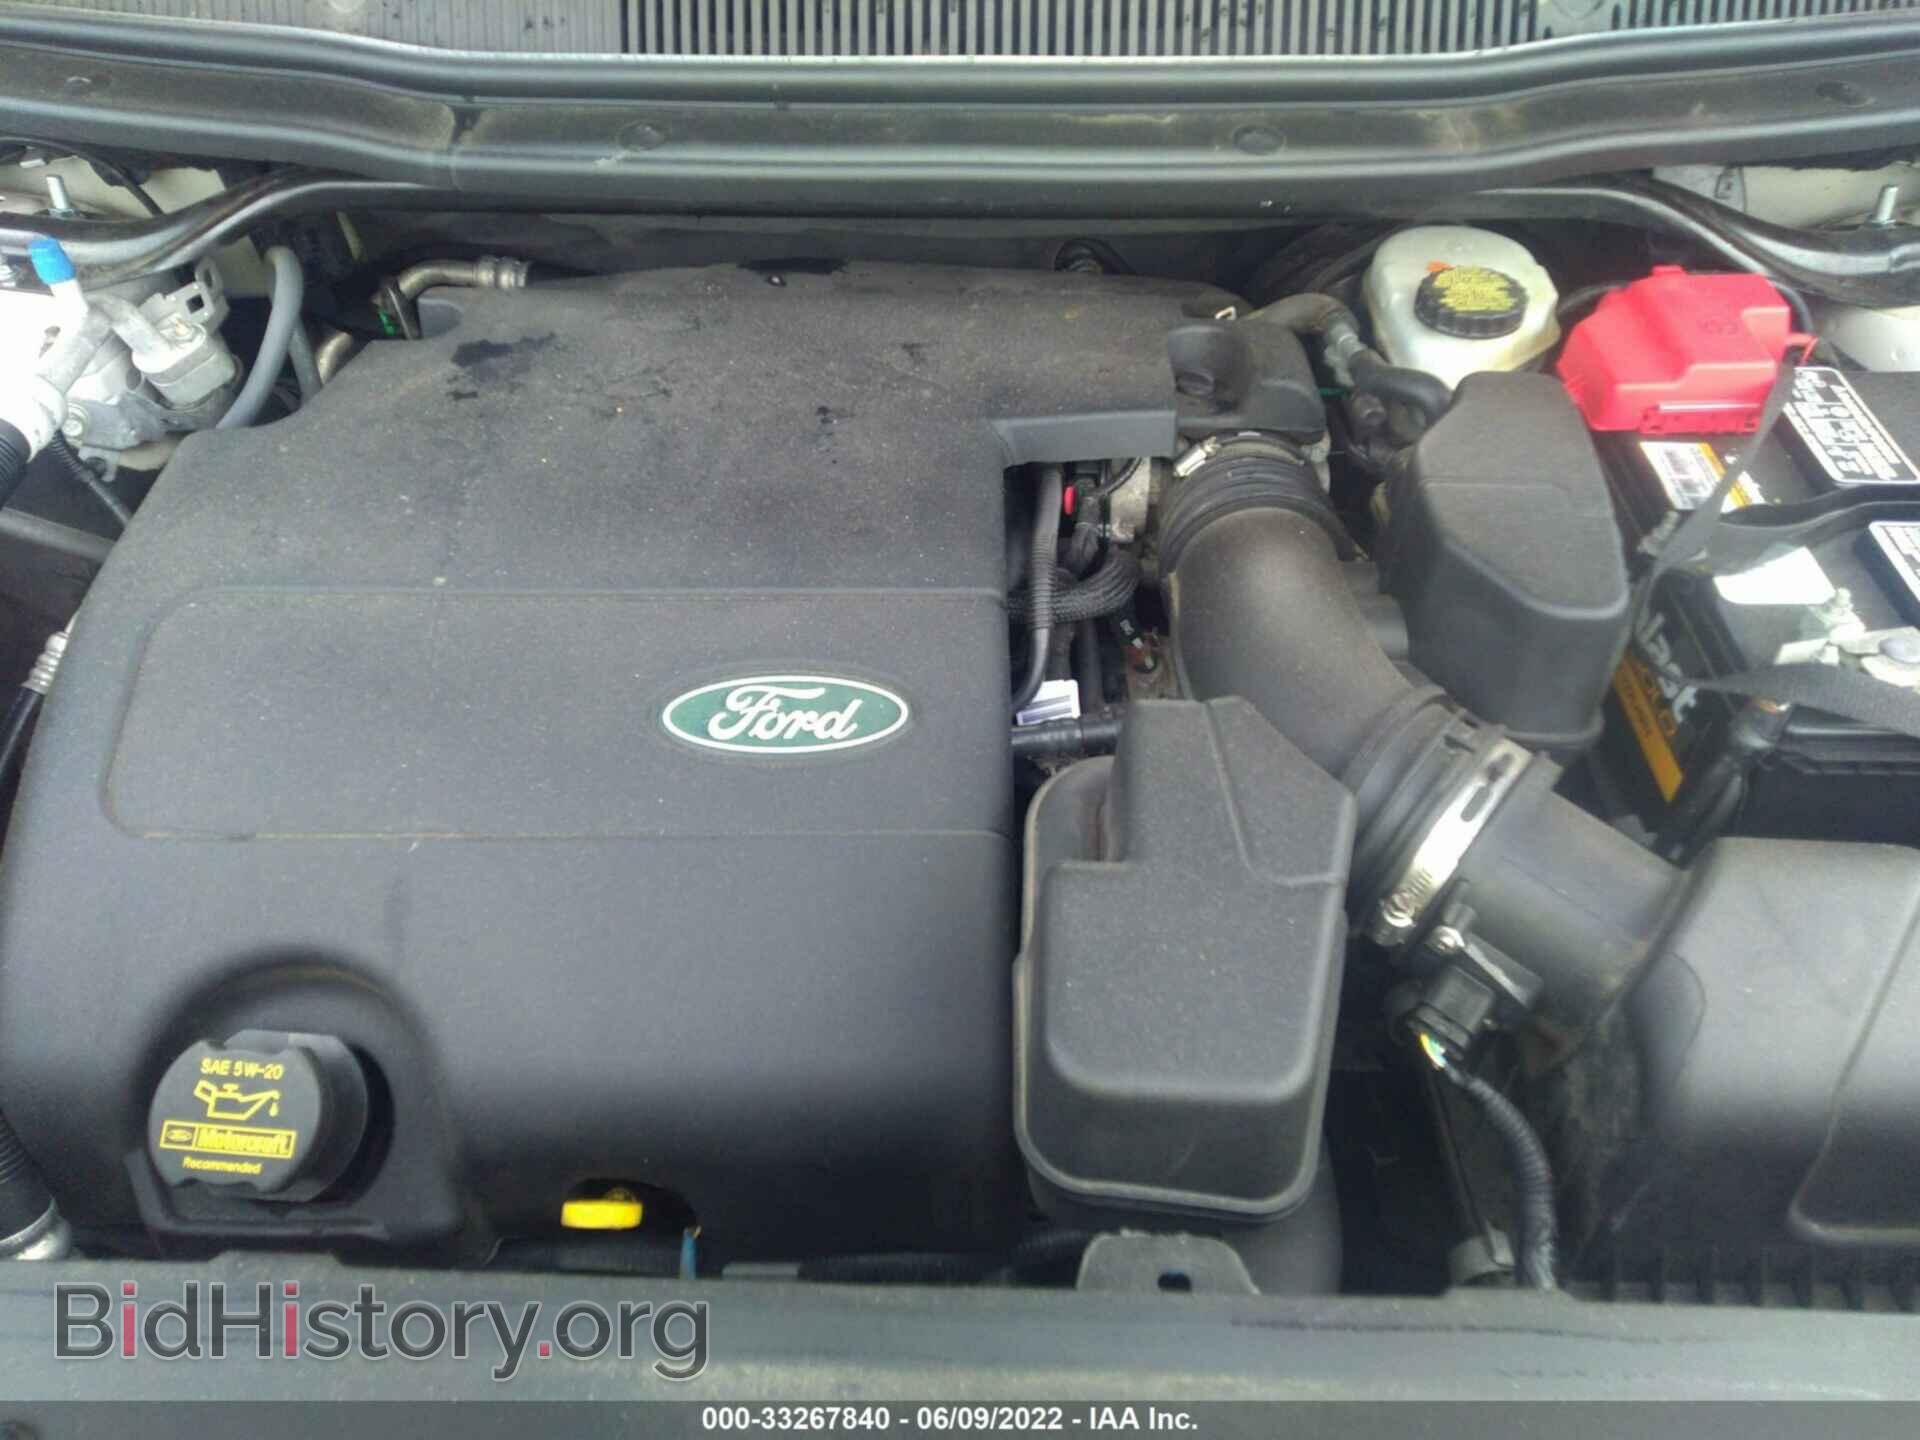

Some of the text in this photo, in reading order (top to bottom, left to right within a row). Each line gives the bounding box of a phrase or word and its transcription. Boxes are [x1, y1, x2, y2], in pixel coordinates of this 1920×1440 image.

[707, 685, 863, 740] Ford
[200, 1058, 285, 1081] SAE 5W-20
